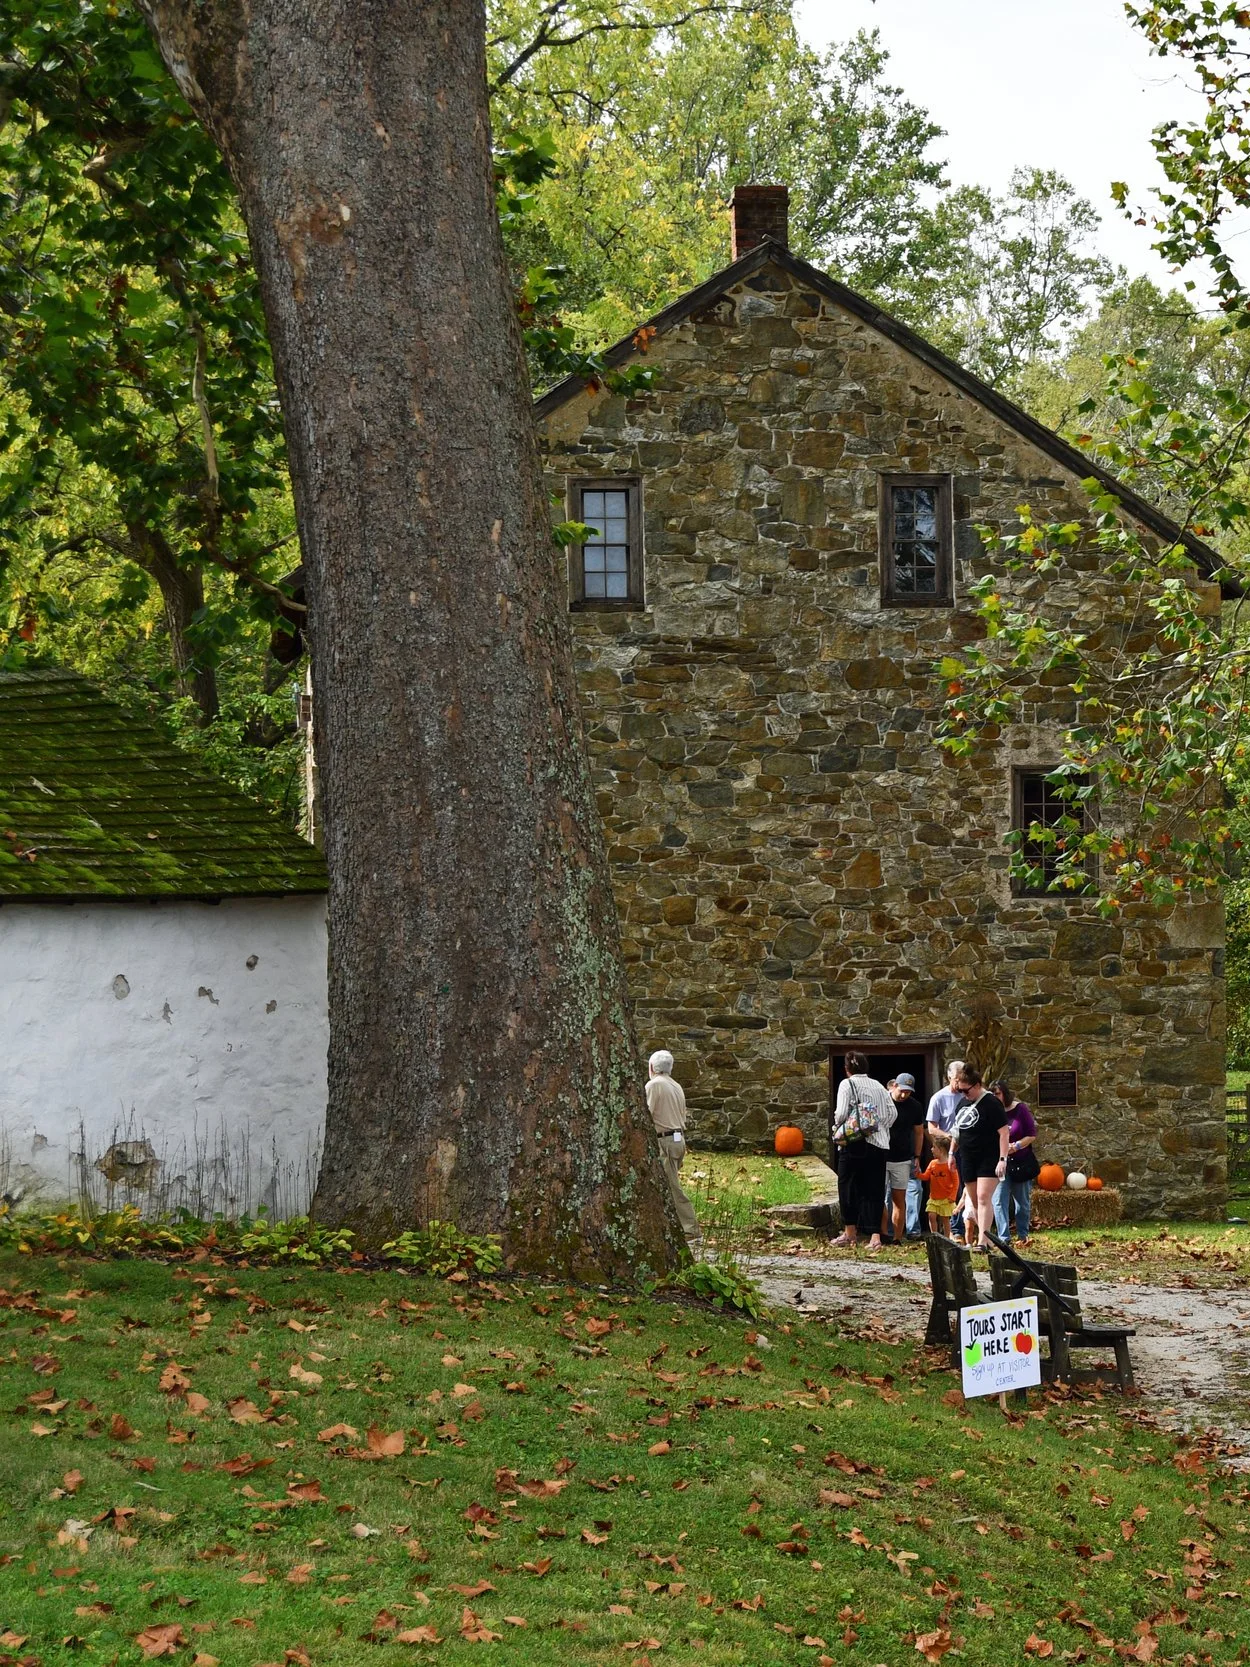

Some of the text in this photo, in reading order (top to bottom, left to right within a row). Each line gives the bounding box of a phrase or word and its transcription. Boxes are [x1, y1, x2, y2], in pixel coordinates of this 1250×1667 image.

[966, 1309, 1032, 1342] TOURS START
[983, 1337, 1010, 1357] HERE
[997, 1361, 1007, 1374] AT
[1009, 1357, 1031, 1373] VISITOR
[996, 1374, 1016, 1386] CENTER
